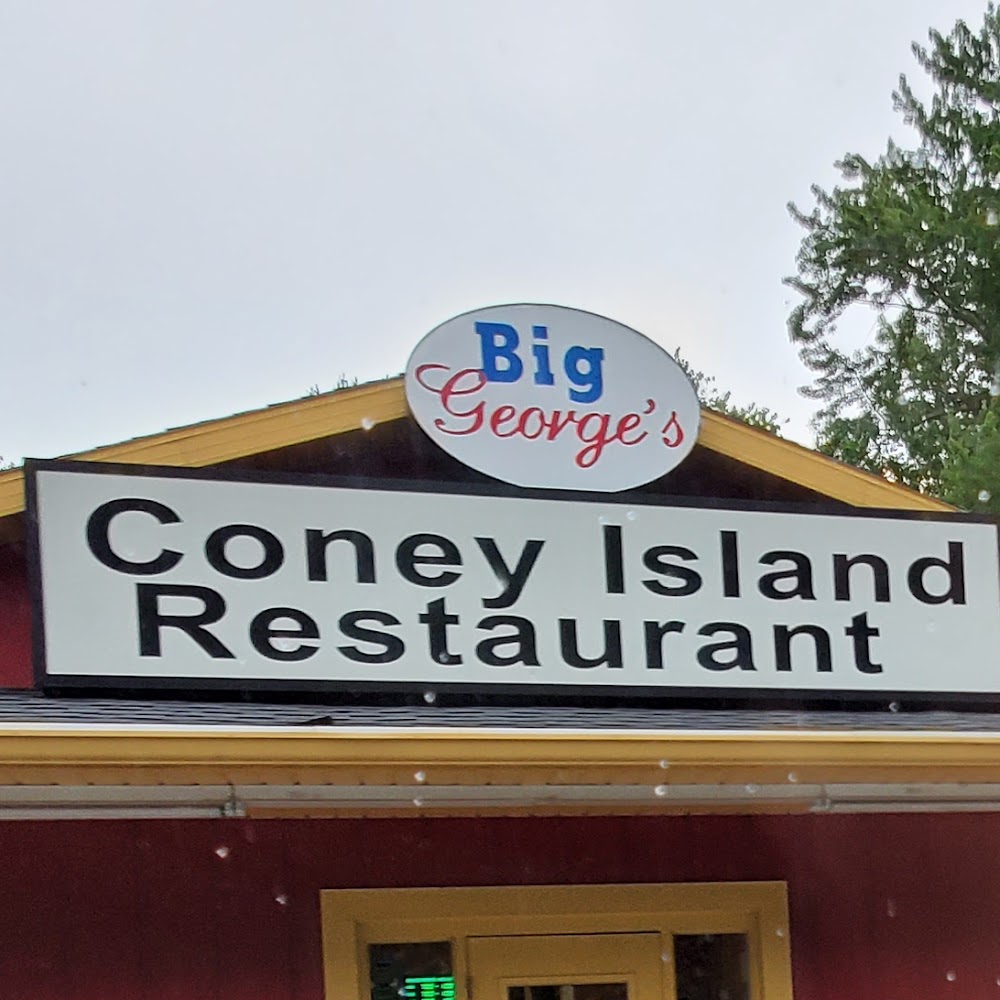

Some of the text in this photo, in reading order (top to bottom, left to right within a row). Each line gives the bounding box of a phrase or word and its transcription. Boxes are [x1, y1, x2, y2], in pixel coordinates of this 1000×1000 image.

[474, 322, 604, 403] Big
[415, 364, 684, 468] George's
[86, 498, 967, 608] Coney Island
[135, 582, 884, 674] Restaurant
